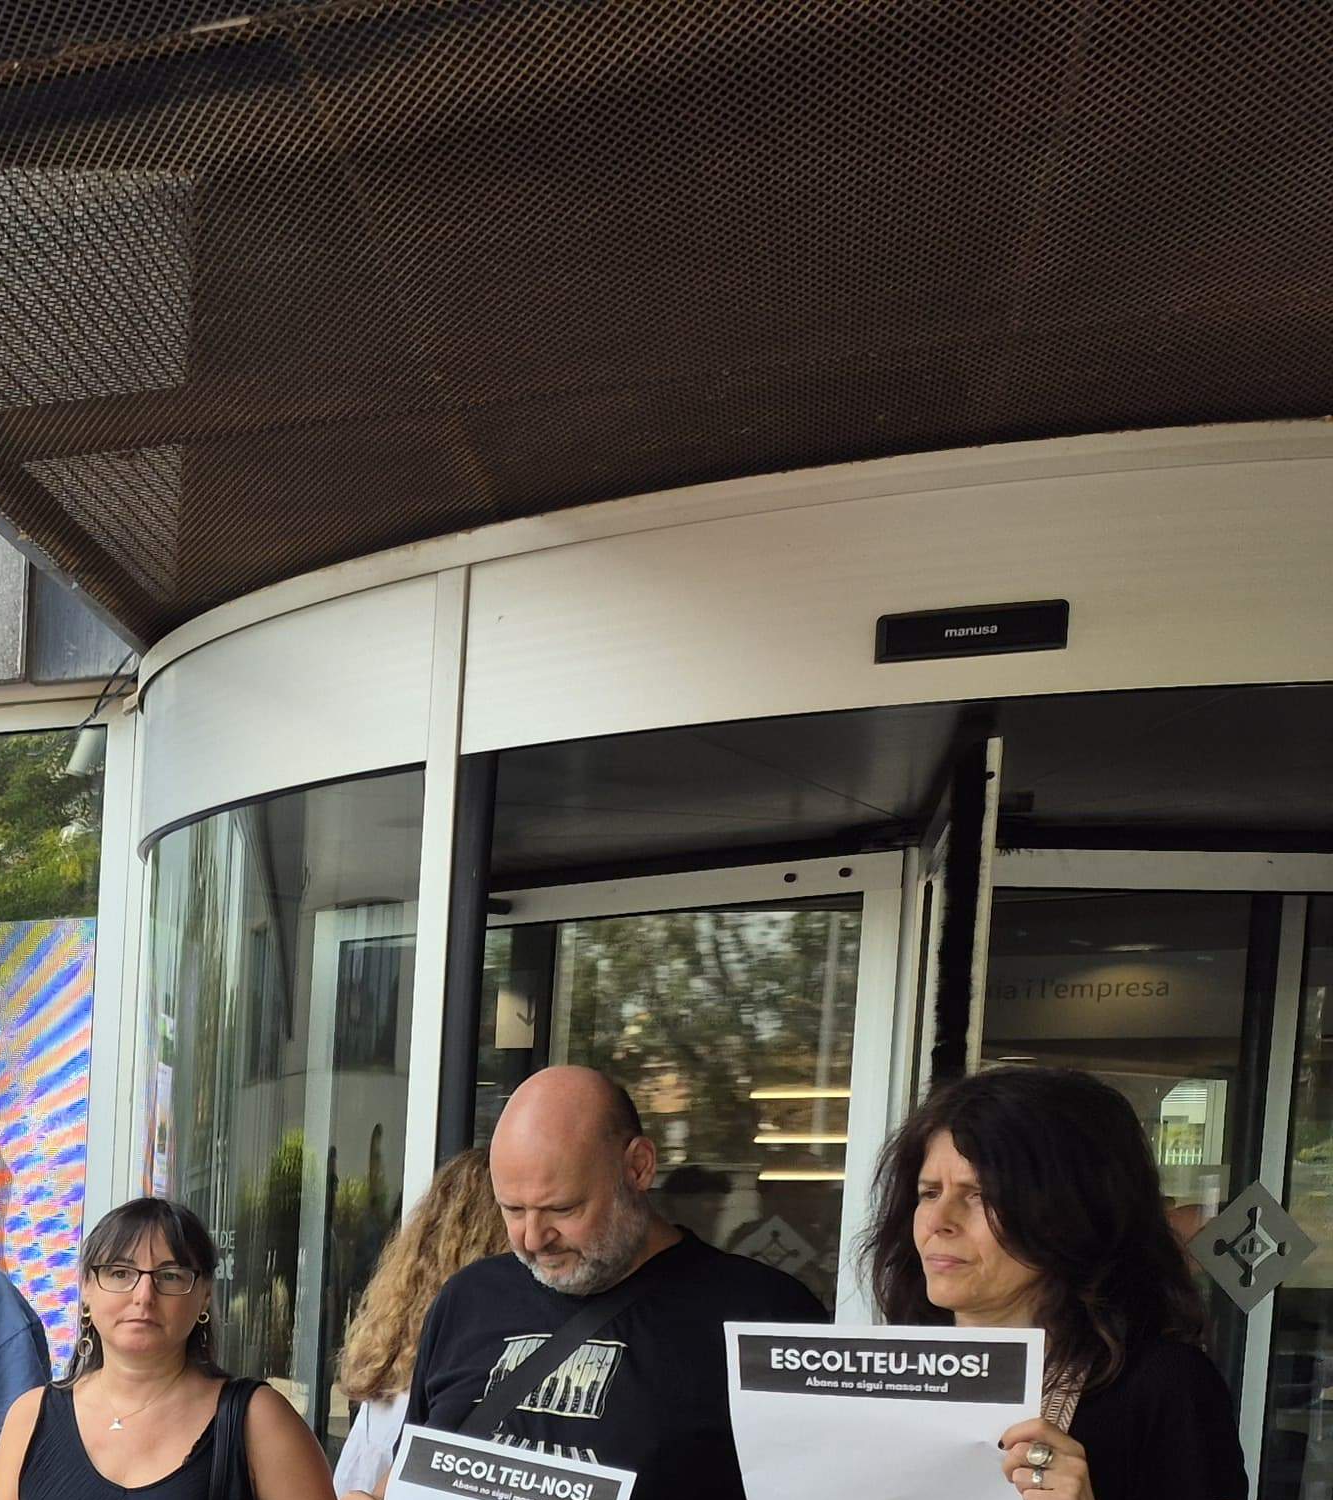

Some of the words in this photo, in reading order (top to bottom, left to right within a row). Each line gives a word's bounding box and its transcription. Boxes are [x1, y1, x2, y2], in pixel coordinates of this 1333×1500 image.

[944, 624, 998, 638] manusa
[1041, 977, 1170, 1003] l'empresa
[770, 1348, 990, 1377] ESCOLTEU-NOS!
[805, 1376, 839, 1388] Abans
[841, 1380, 854, 1389] no
[856, 1379, 883, 1392] sigui
[885, 1382, 922, 1391] massa
[924, 1381, 949, 1393] tard
[452, 1479, 479, 1493] Abans
[479, 1487, 490, 1496] no
[491, 1488, 513, 1500] sigui
